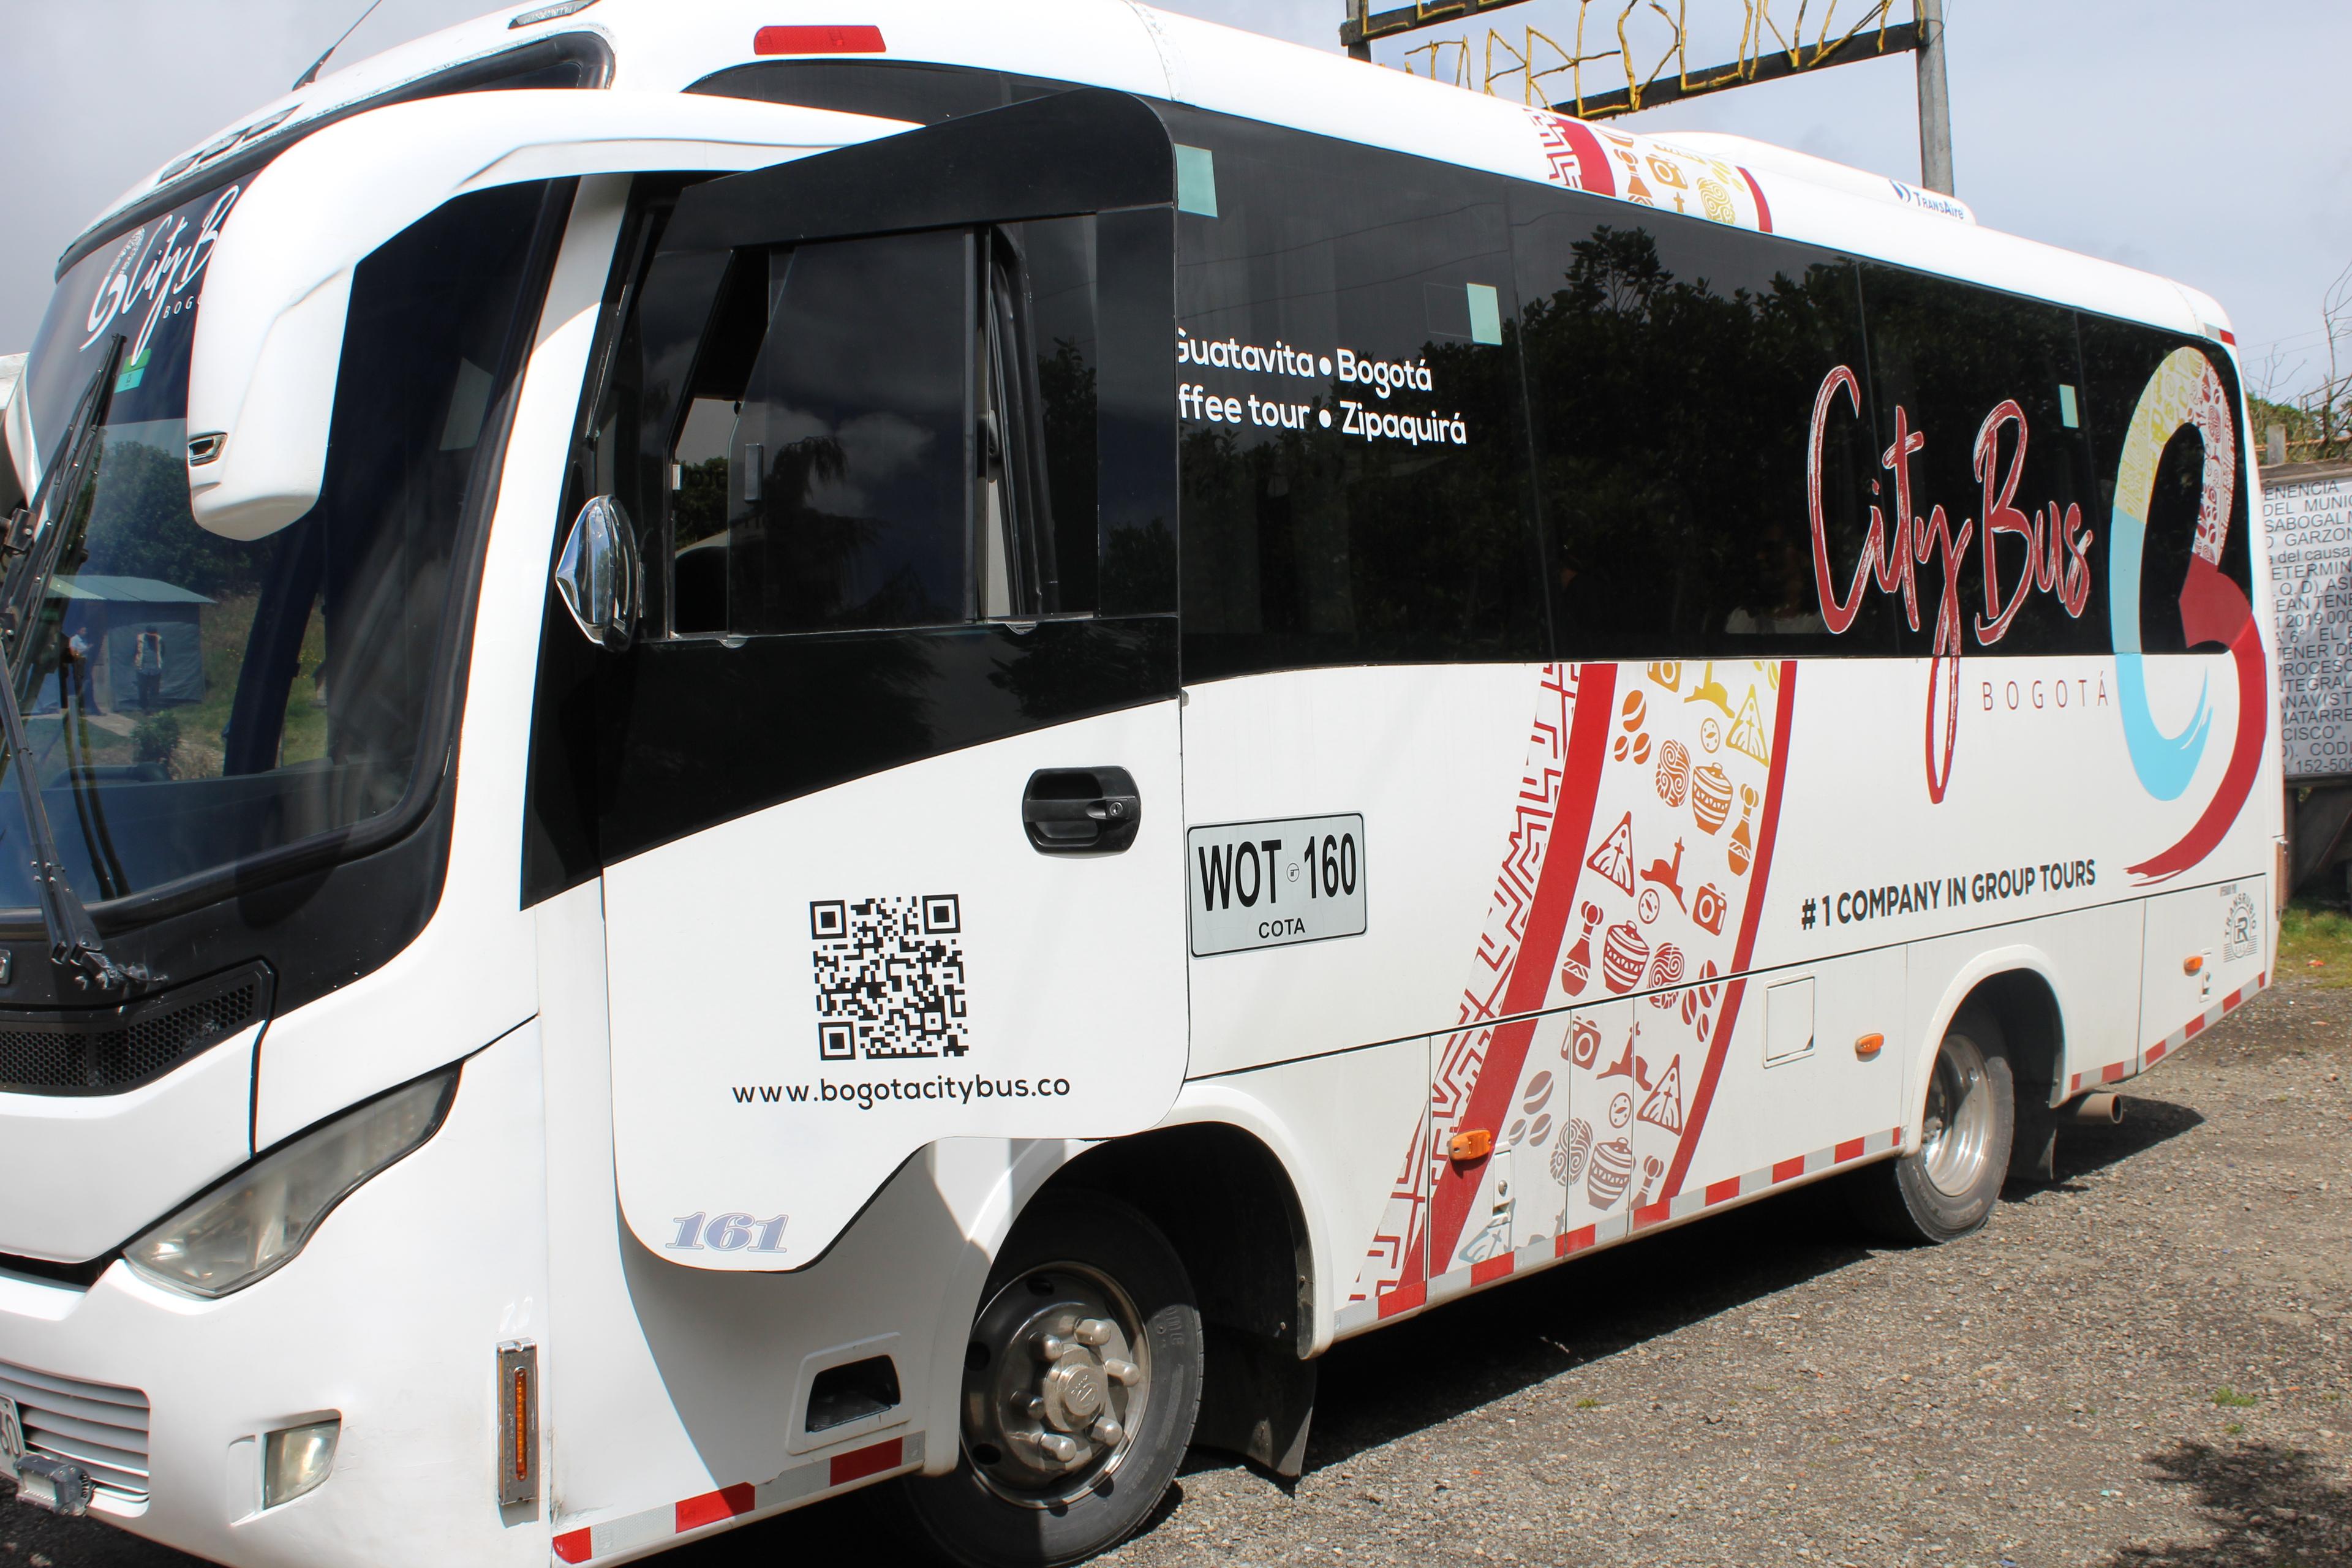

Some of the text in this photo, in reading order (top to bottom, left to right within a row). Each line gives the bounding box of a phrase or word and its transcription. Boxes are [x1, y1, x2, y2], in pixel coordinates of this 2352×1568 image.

[163, 294, 203, 318] BOG
[1336, 348, 1433, 399] Bogotá
[1178, 383, 1466, 445] ffee tour Zipaquirá
[2263, 502, 2294, 516] DEL
[2264, 512, 2345, 533] SABOGAL
[2278, 549, 2299, 564] del
[1807, 365, 2092, 804] City Bus
[2286, 612, 2323, 627] 2019
[2320, 628, 2339, 641] EL
[1982, 672, 2108, 711] BOGOTÁ
[1198, 833, 1356, 911] WOT 160
[1837, 880, 1942, 924] COMPANY
[1947, 876, 1967, 908] IN
[1971, 867, 2035, 903] GROUP
[2040, 859, 2095, 892] TOURS
[1259, 918, 1305, 938] COTA
[732, 1074, 1070, 1109] www.bogotacitybus.co
[665, 1212, 789, 1253] 161
